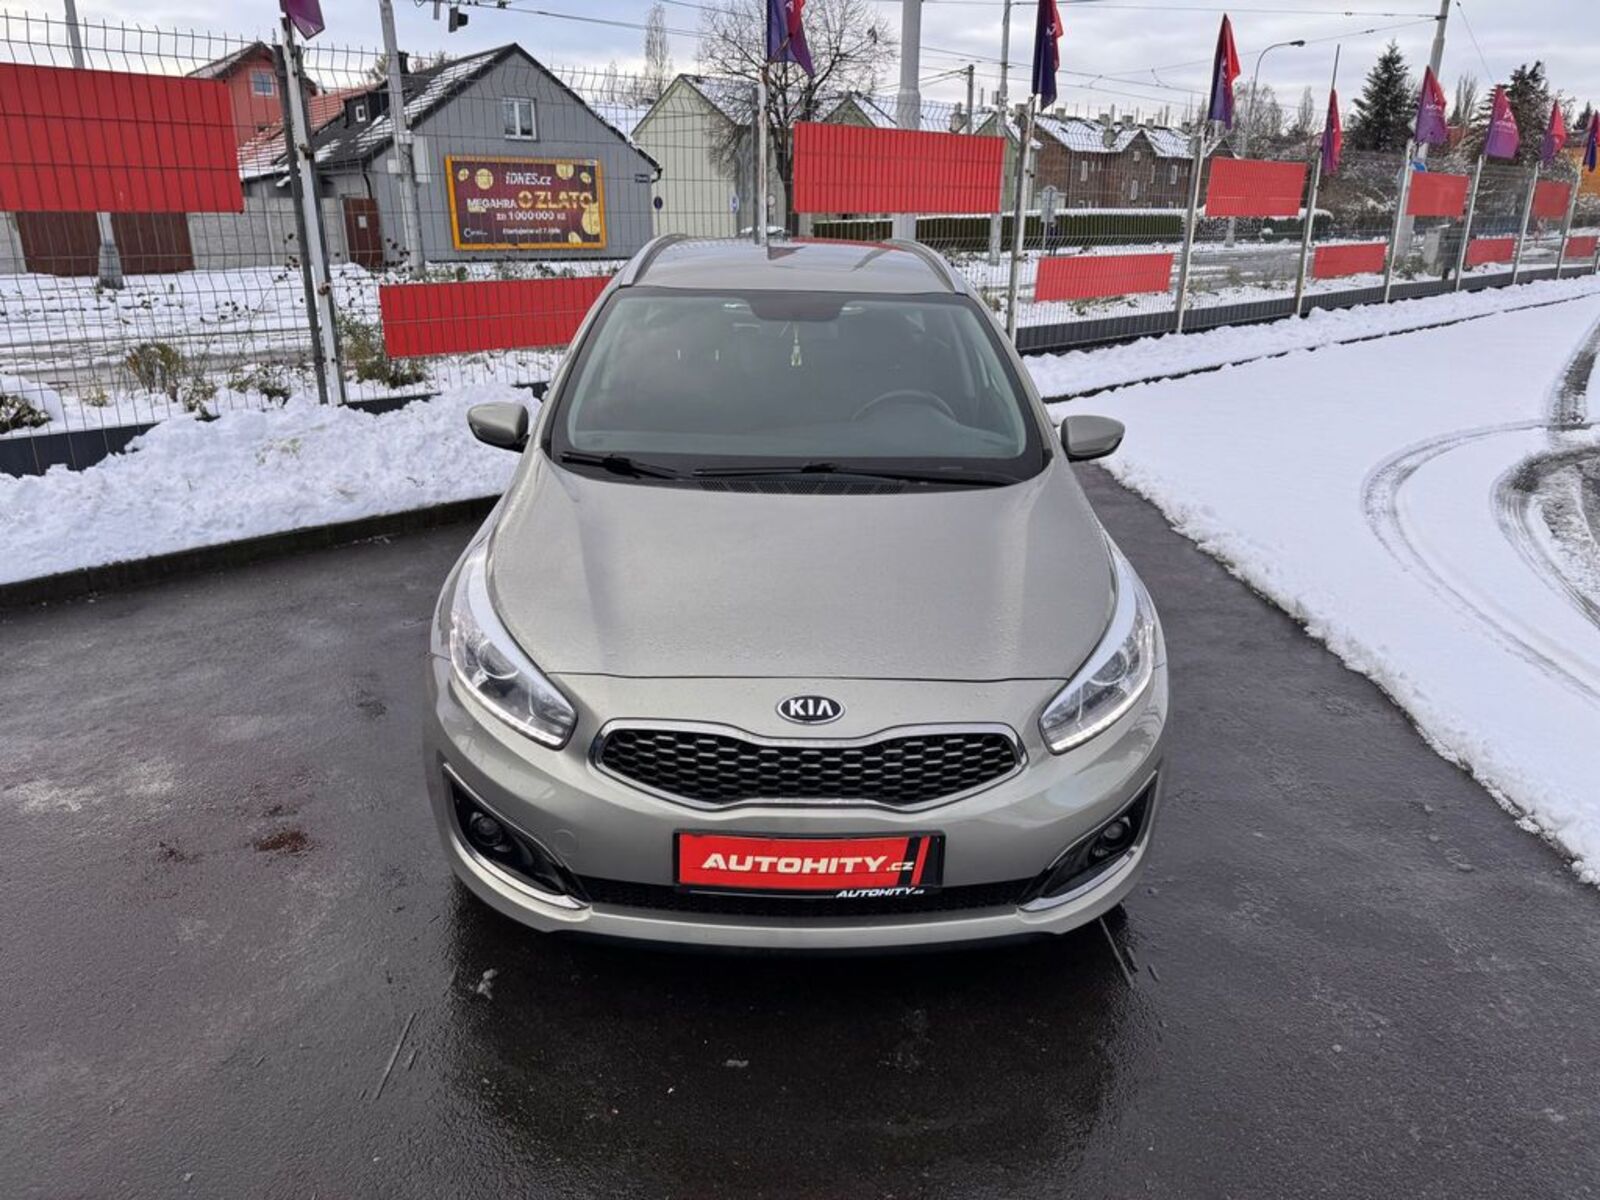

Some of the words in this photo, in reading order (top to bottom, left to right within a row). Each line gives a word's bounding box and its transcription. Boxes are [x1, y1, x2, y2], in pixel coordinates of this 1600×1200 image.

[505, 171, 552, 186] iDNES.cz
[466, 198, 518, 209] MEGAHRA
[534, 190, 593, 209] ZLATO
[789, 698, 834, 717] KIA
[836, 886, 925, 899] AUTOHITY.
